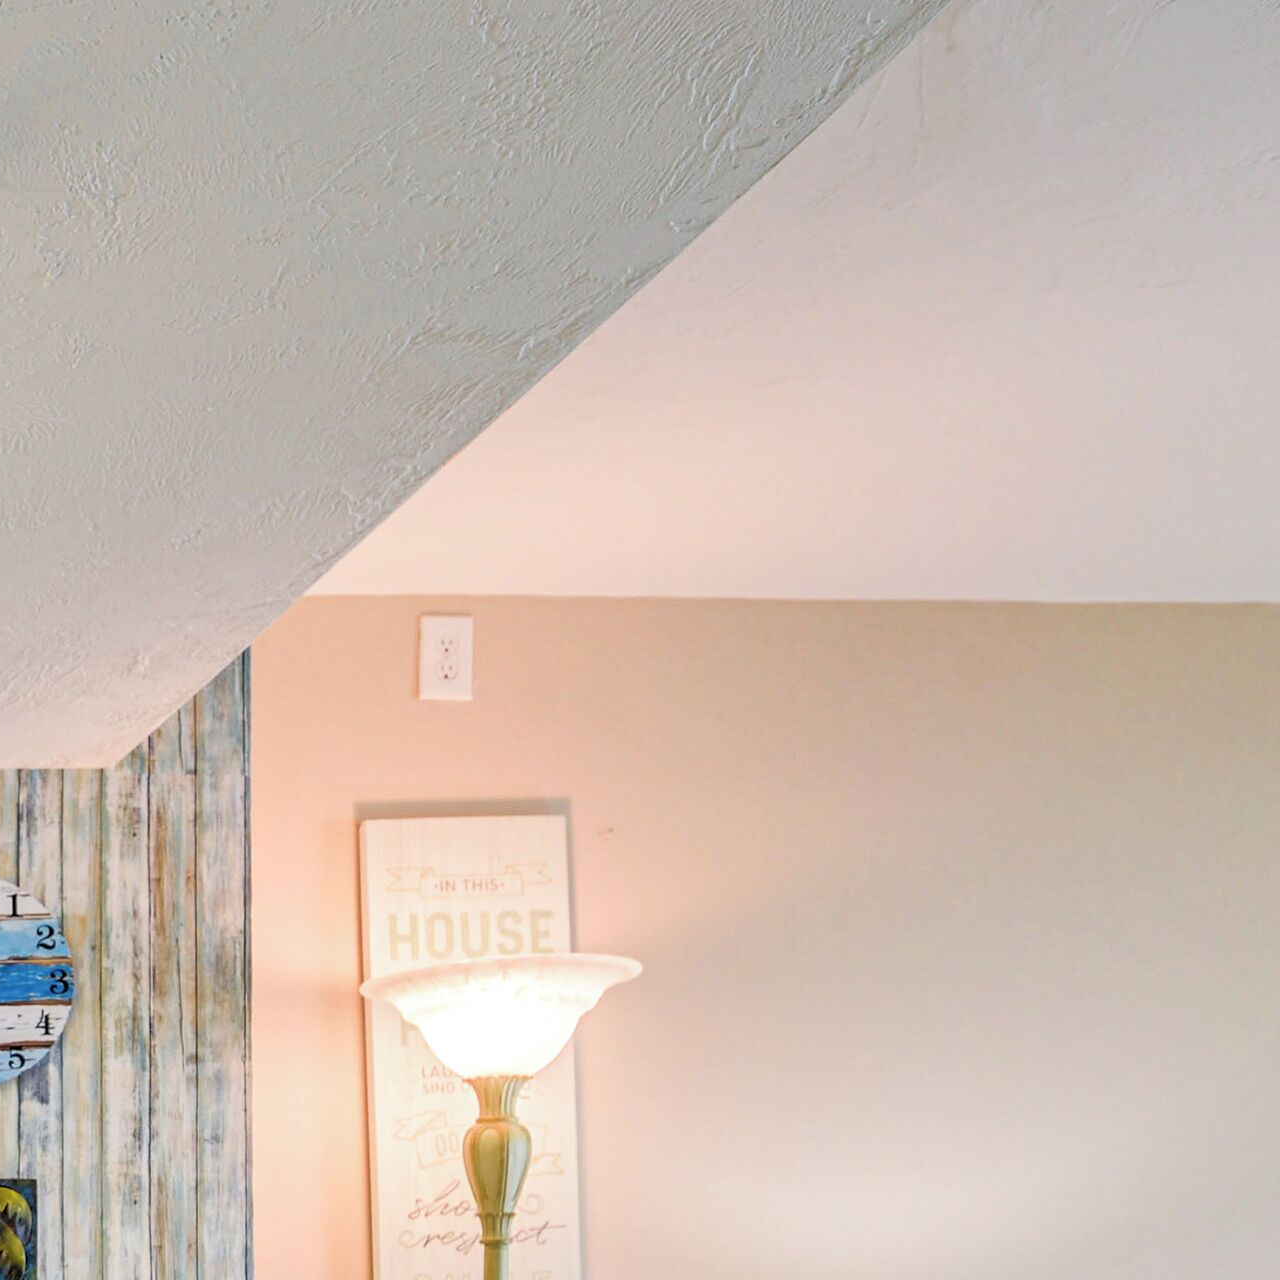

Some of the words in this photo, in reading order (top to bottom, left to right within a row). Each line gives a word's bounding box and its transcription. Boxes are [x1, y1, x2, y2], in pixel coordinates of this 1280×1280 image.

[439, 880, 456, 893] IN
[462, 878, 499, 892] THIS
[6, 893, 20, 917] 1
[36, 924, 56, 950] 2
[387, 909, 556, 961] HOUSE
[49, 969, 70, 995] 3
[35, 1009, 55, 1036] 4
[8, 1047, 26, 1070] 5
